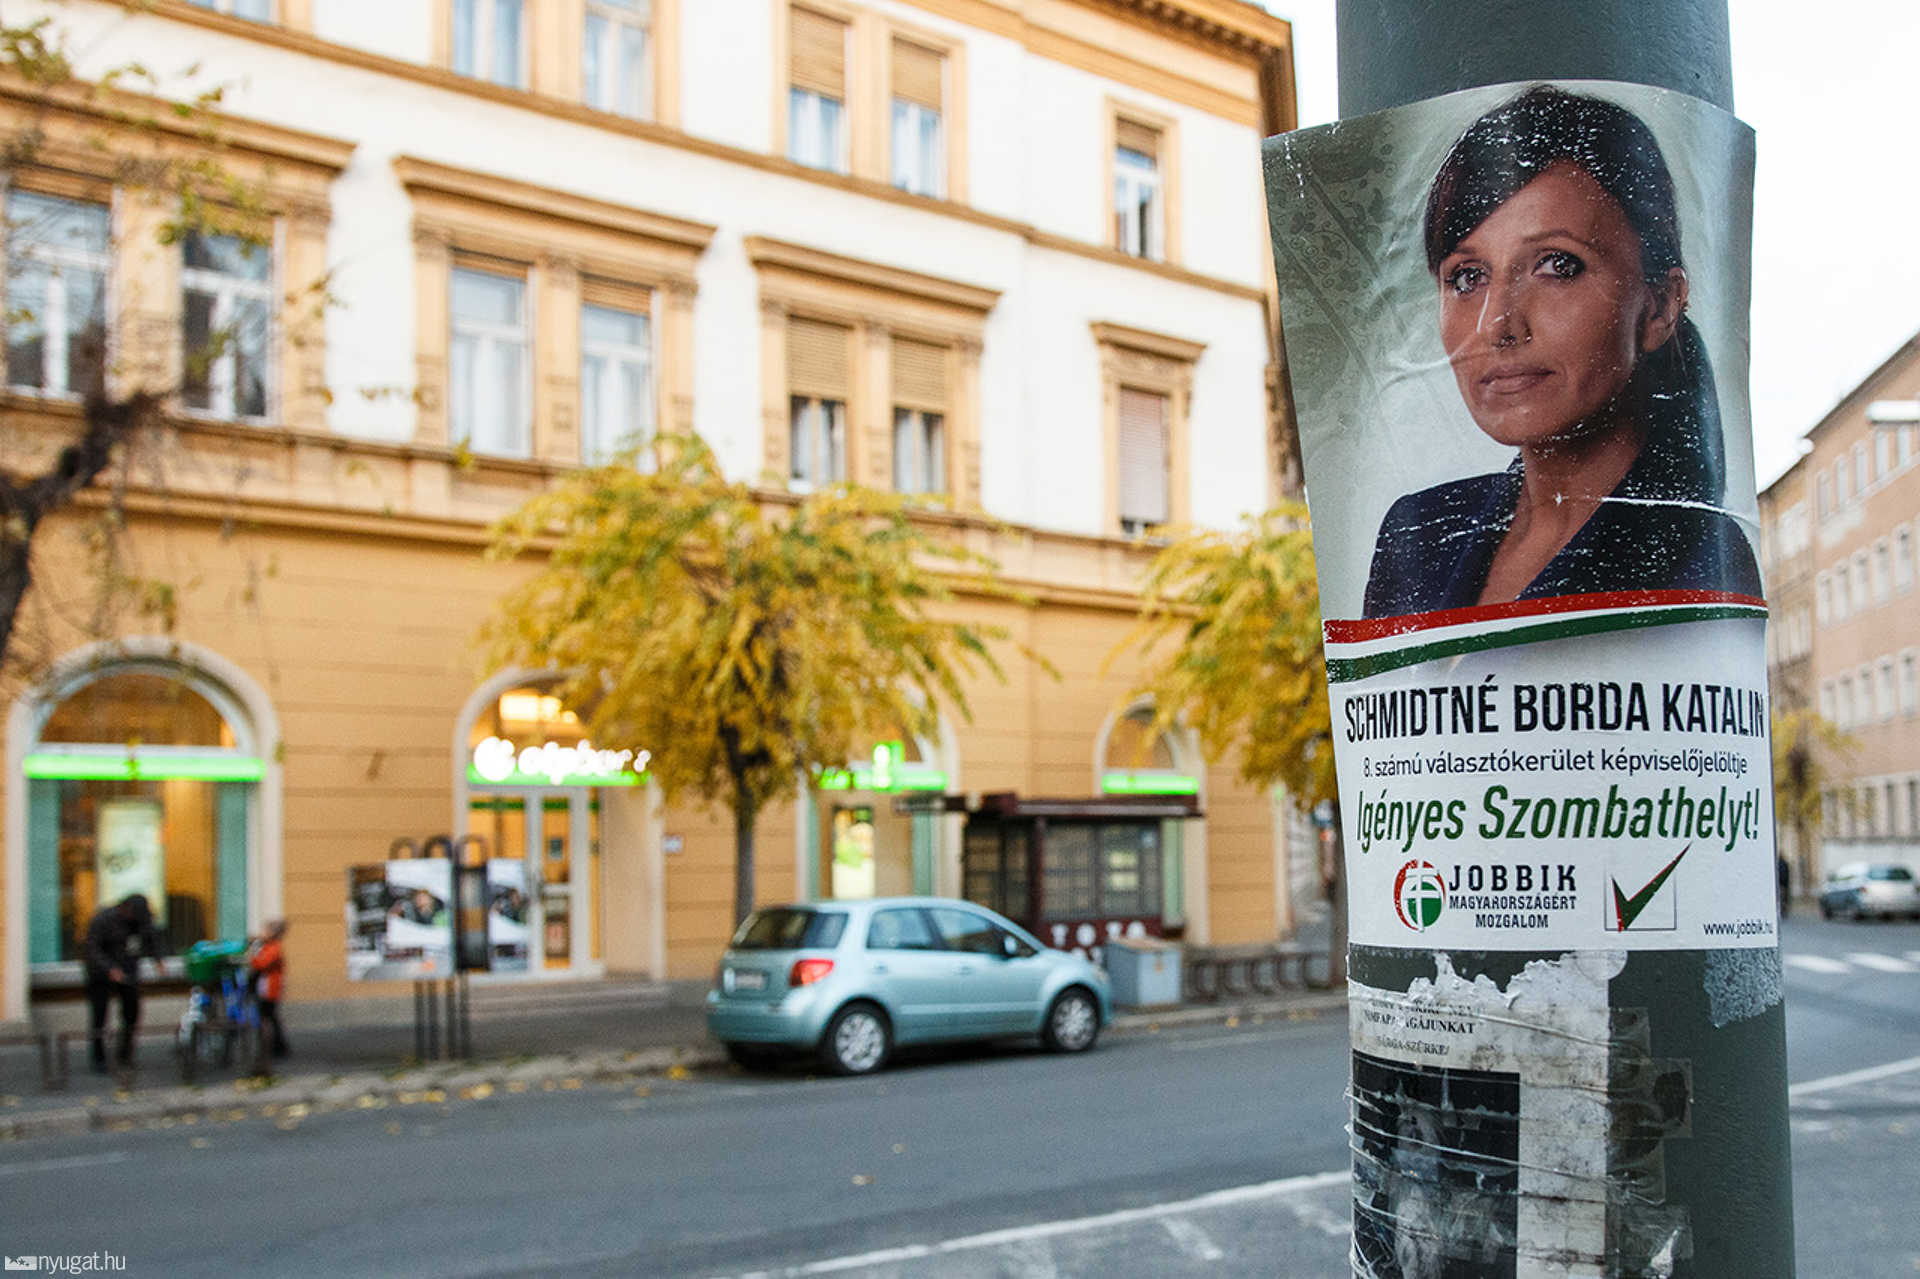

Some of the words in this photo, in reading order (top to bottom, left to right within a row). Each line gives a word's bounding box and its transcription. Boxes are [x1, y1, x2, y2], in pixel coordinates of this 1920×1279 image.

[1345, 674, 1499, 743] SCHMIDTNÉ
[1514, 682, 1650, 732] BORDA
[1662, 683, 1765, 738] KATALIN
[1363, 757, 1373, 777] 8.
[1375, 752, 1421, 776] számú
[1426, 748, 1595, 774] választókerület
[1601, 746, 1748, 778] képviselőjelöltje
[1357, 788, 1466, 854] Igényes
[1478, 784, 1760, 852] Szombathelyt!
[1449, 864, 1576, 892] JOBBIK
[1449, 894, 1576, 911] MAGYARORSZÁGÉRT
[1475, 914, 1549, 928] MOZGALOM
[1703, 919, 1774, 938] www.jobbik.hu
